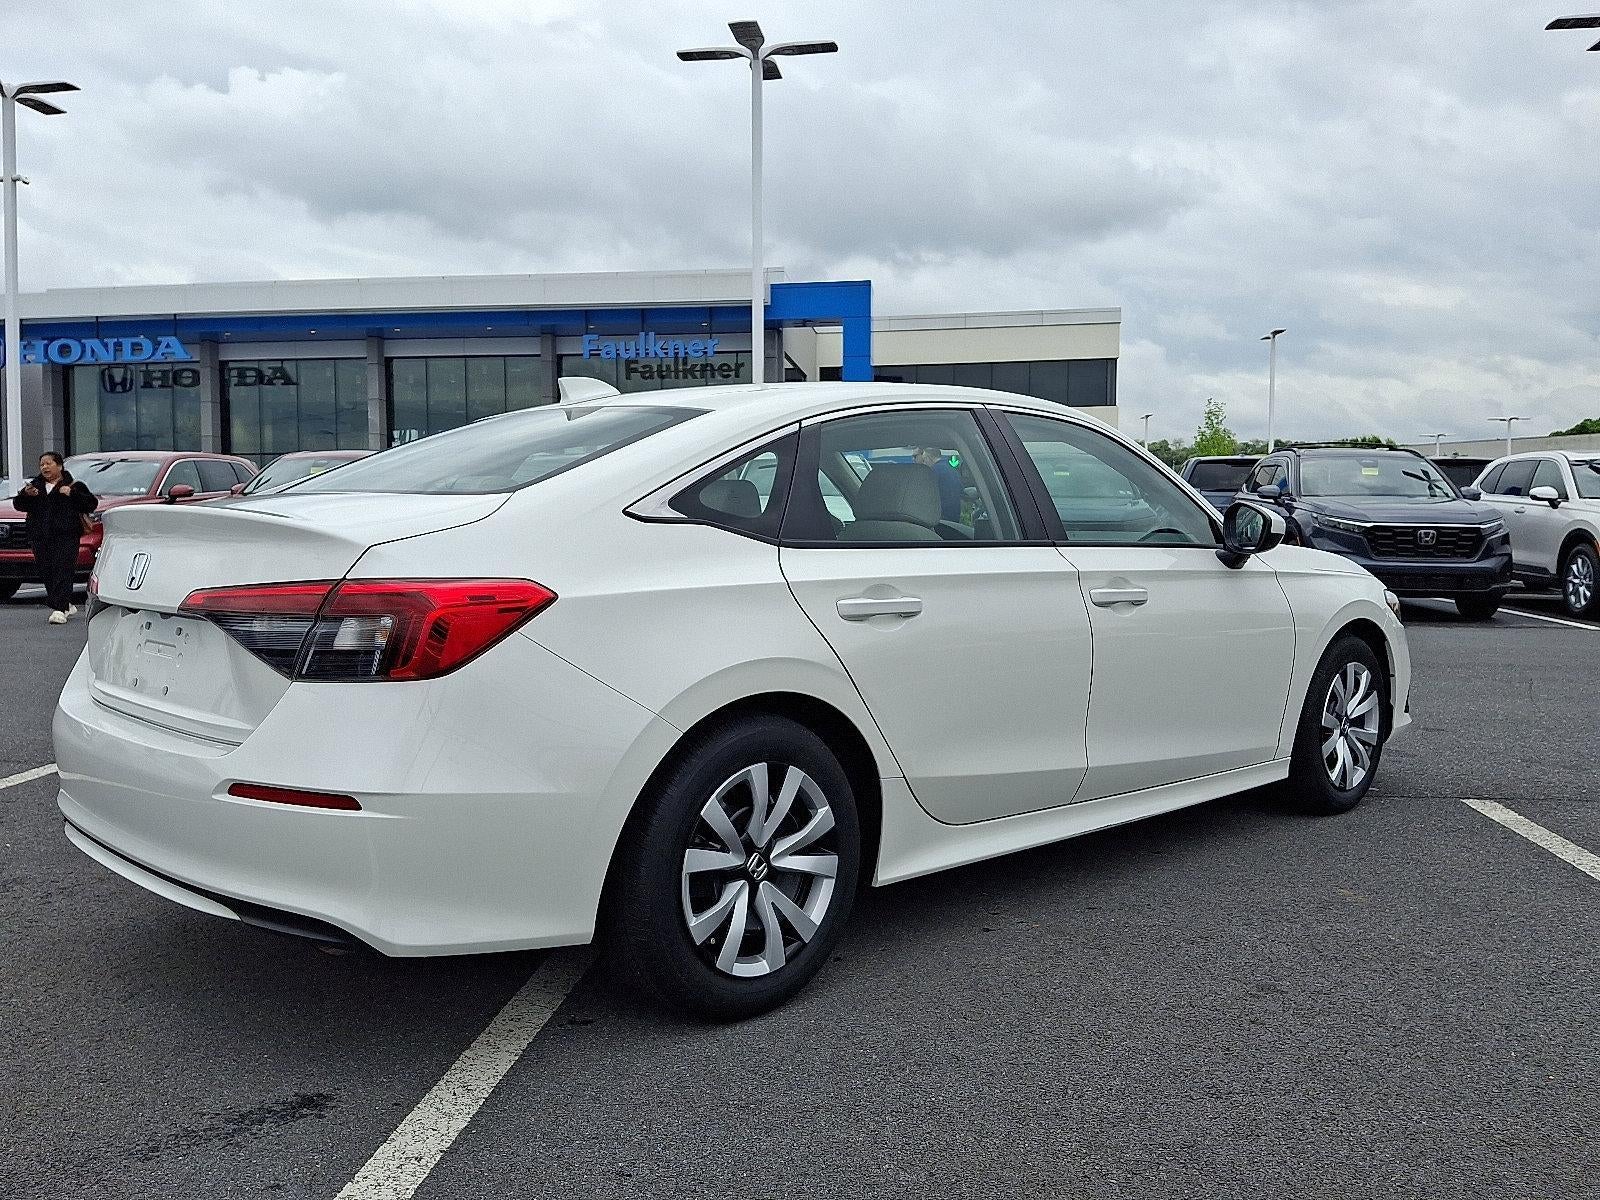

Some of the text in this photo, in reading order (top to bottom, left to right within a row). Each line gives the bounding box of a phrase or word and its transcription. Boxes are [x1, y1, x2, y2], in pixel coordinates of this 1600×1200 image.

[20, 335, 193, 364] HONDA
[582, 332, 720, 359] Faulkner
[625, 356, 745, 380] Faulkner
